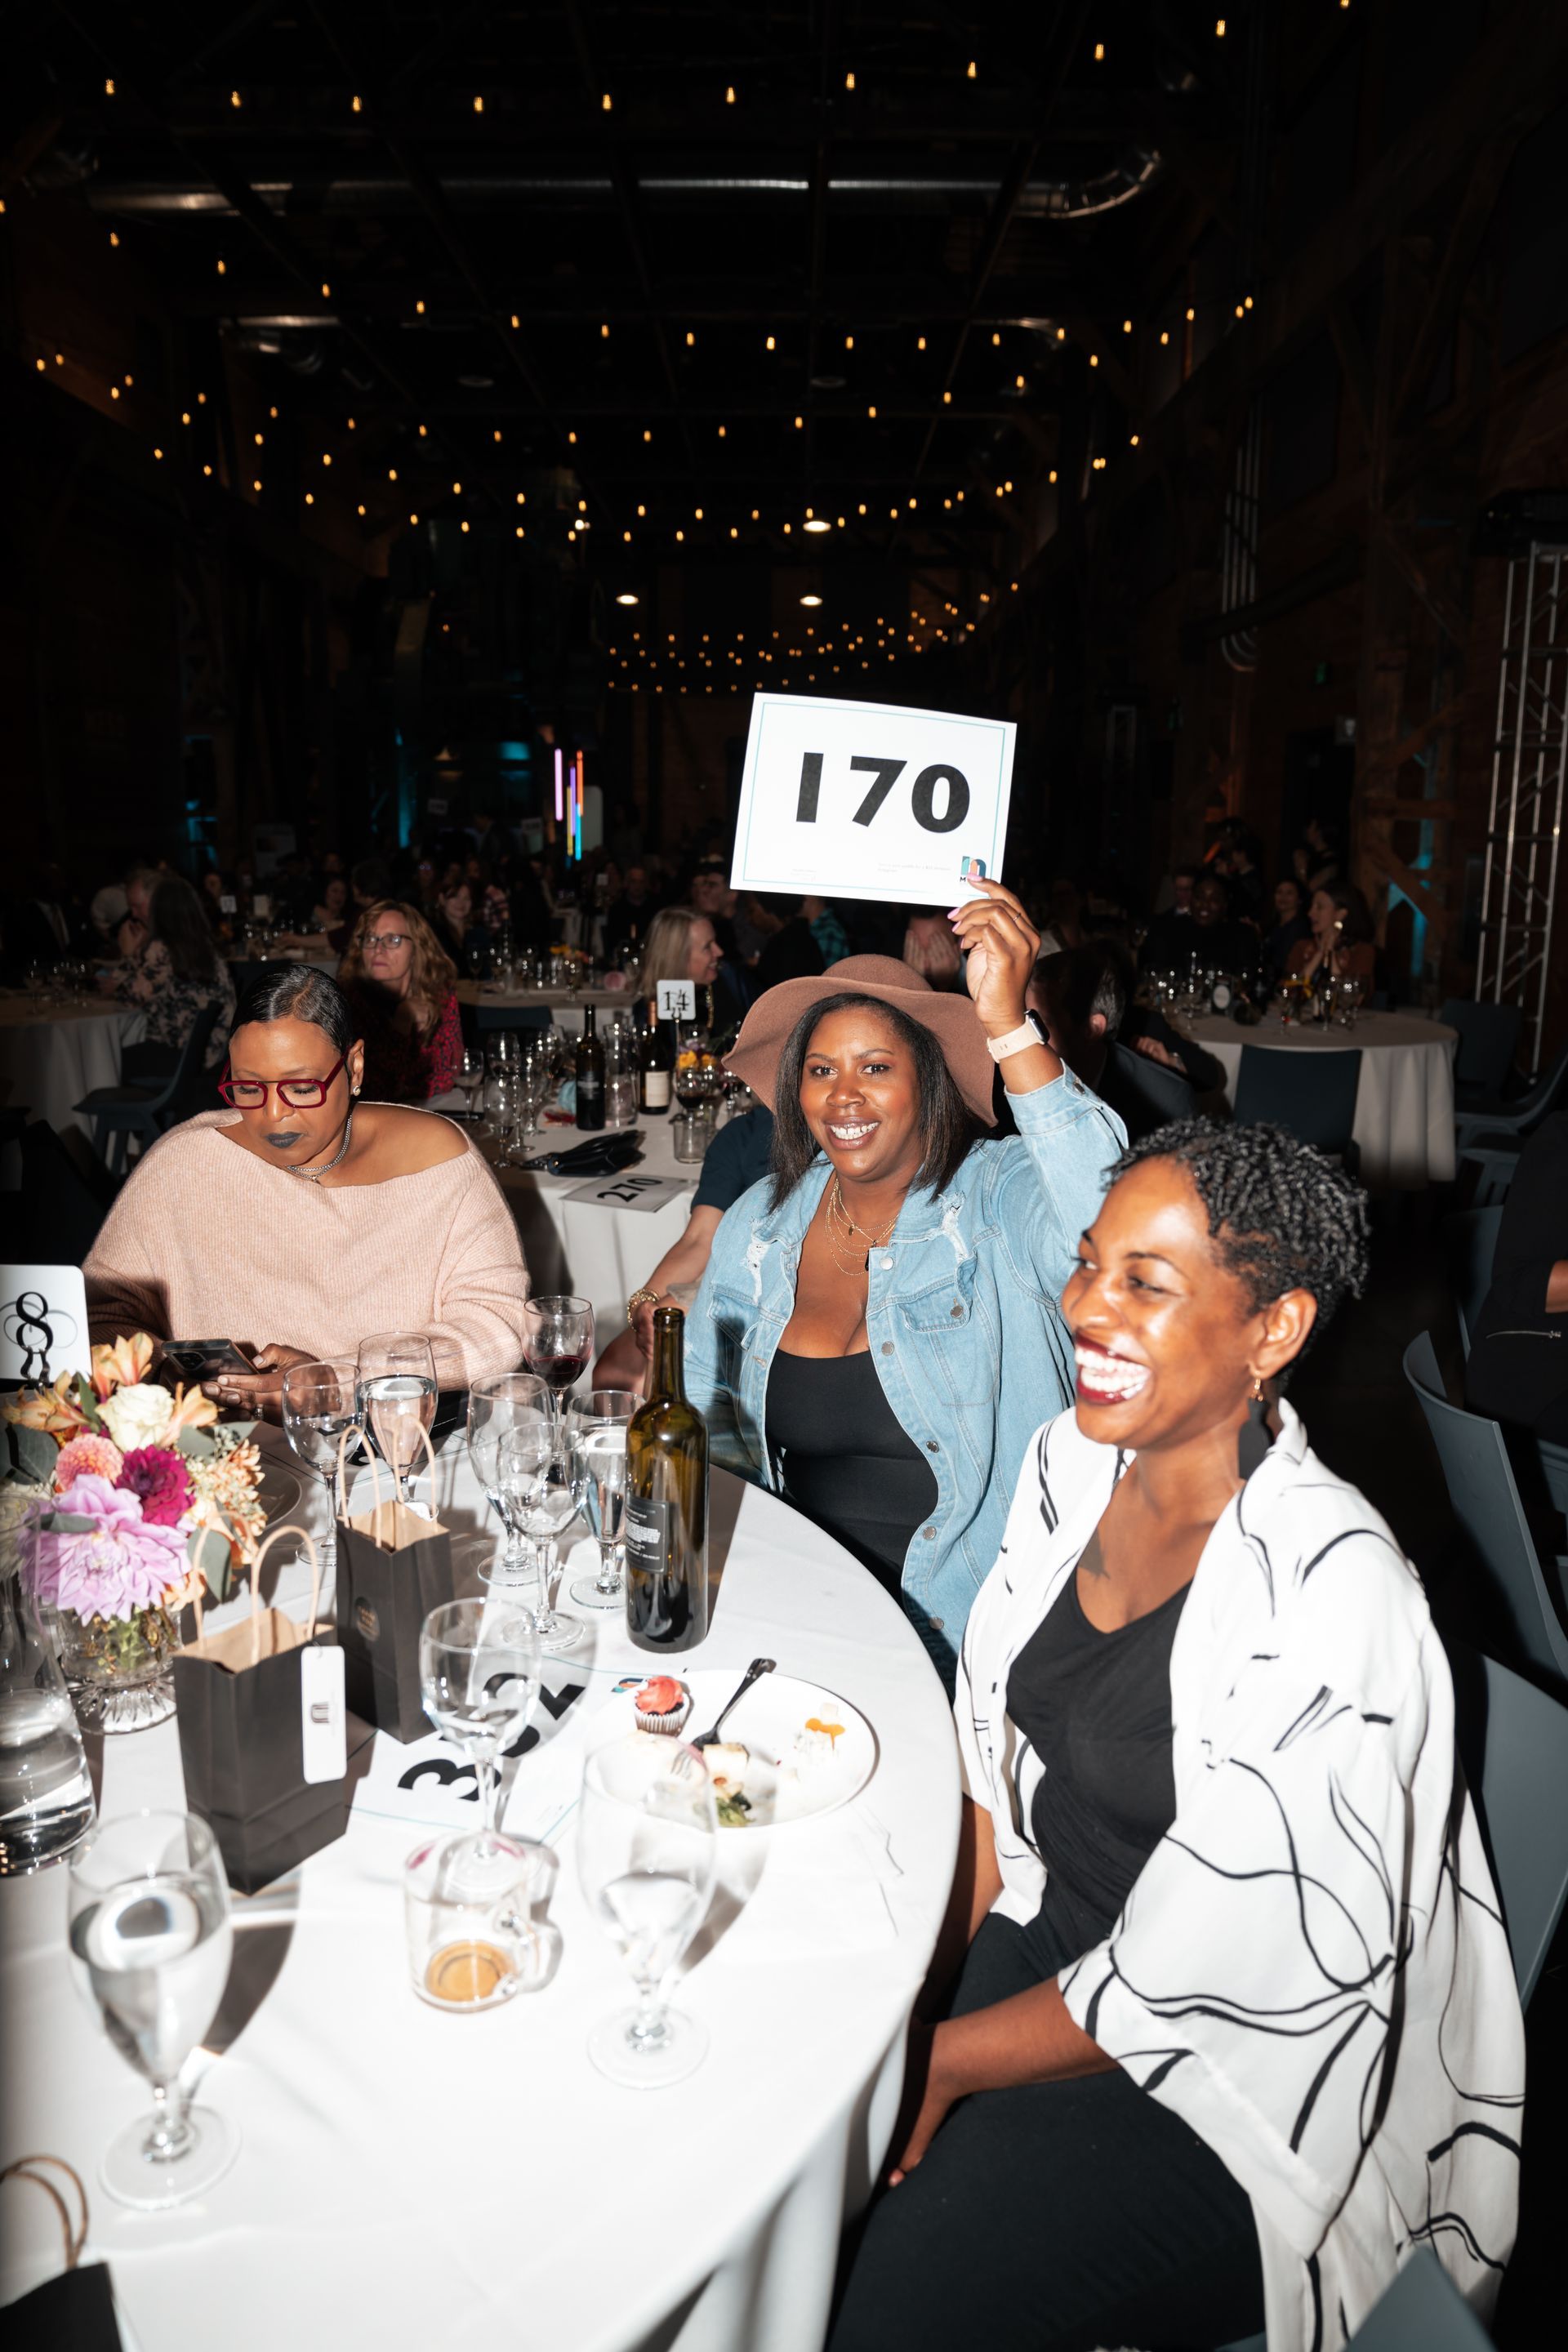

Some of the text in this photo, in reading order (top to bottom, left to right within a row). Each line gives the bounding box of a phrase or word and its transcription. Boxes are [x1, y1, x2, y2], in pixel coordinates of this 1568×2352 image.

[796, 752, 970, 833] 170
[662, 989, 690, 1012] 14
[596, 1178, 664, 1203] 270
[16, 1291, 54, 1354] 8
